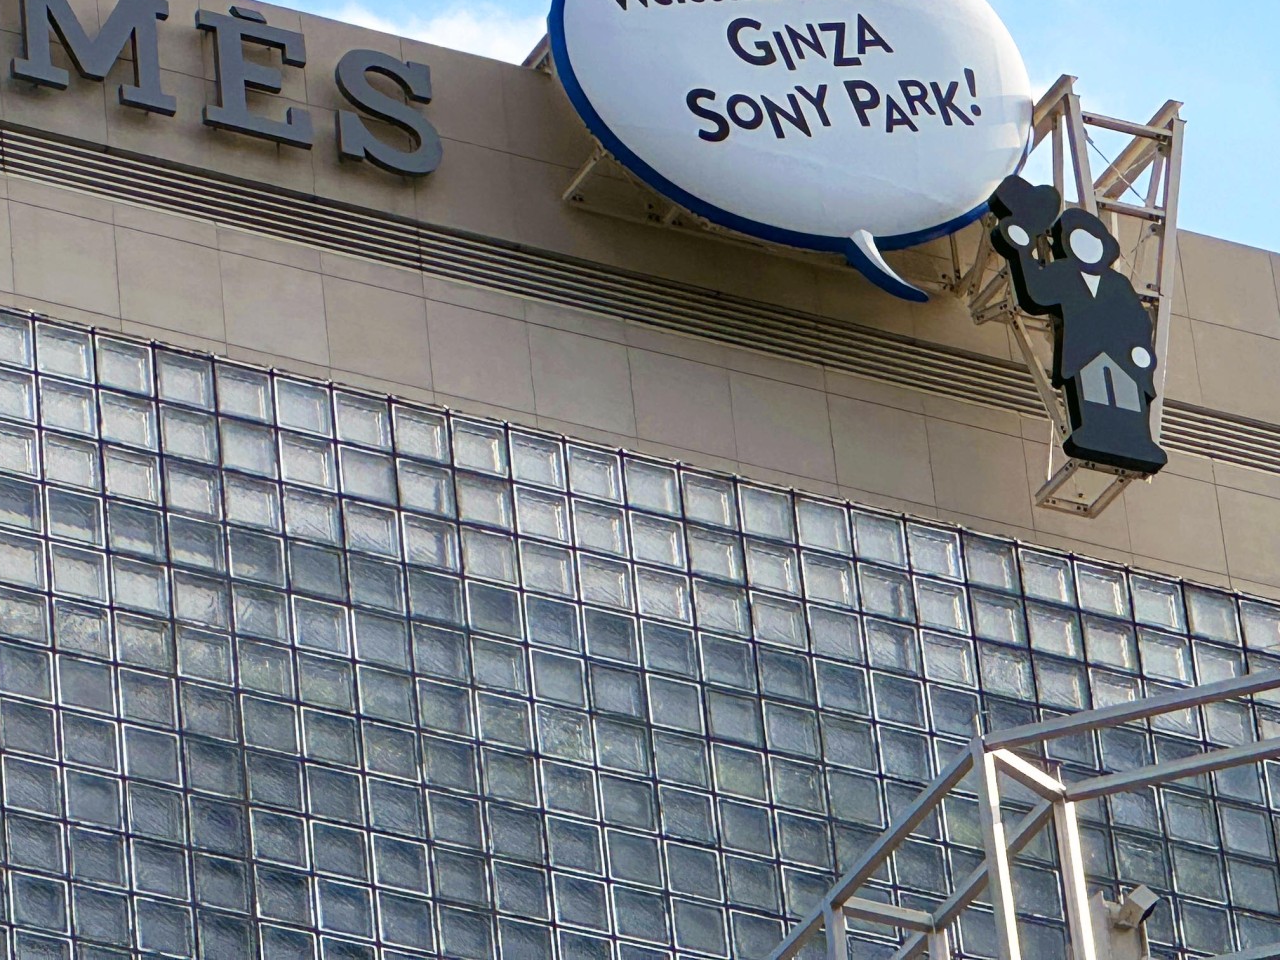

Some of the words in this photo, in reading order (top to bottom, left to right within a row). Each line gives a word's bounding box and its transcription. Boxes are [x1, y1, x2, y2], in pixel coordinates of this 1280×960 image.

[726, 13, 894, 71] GINZA
[685, 84, 832, 142] SONY
[843, 67, 982, 133] PARK!
